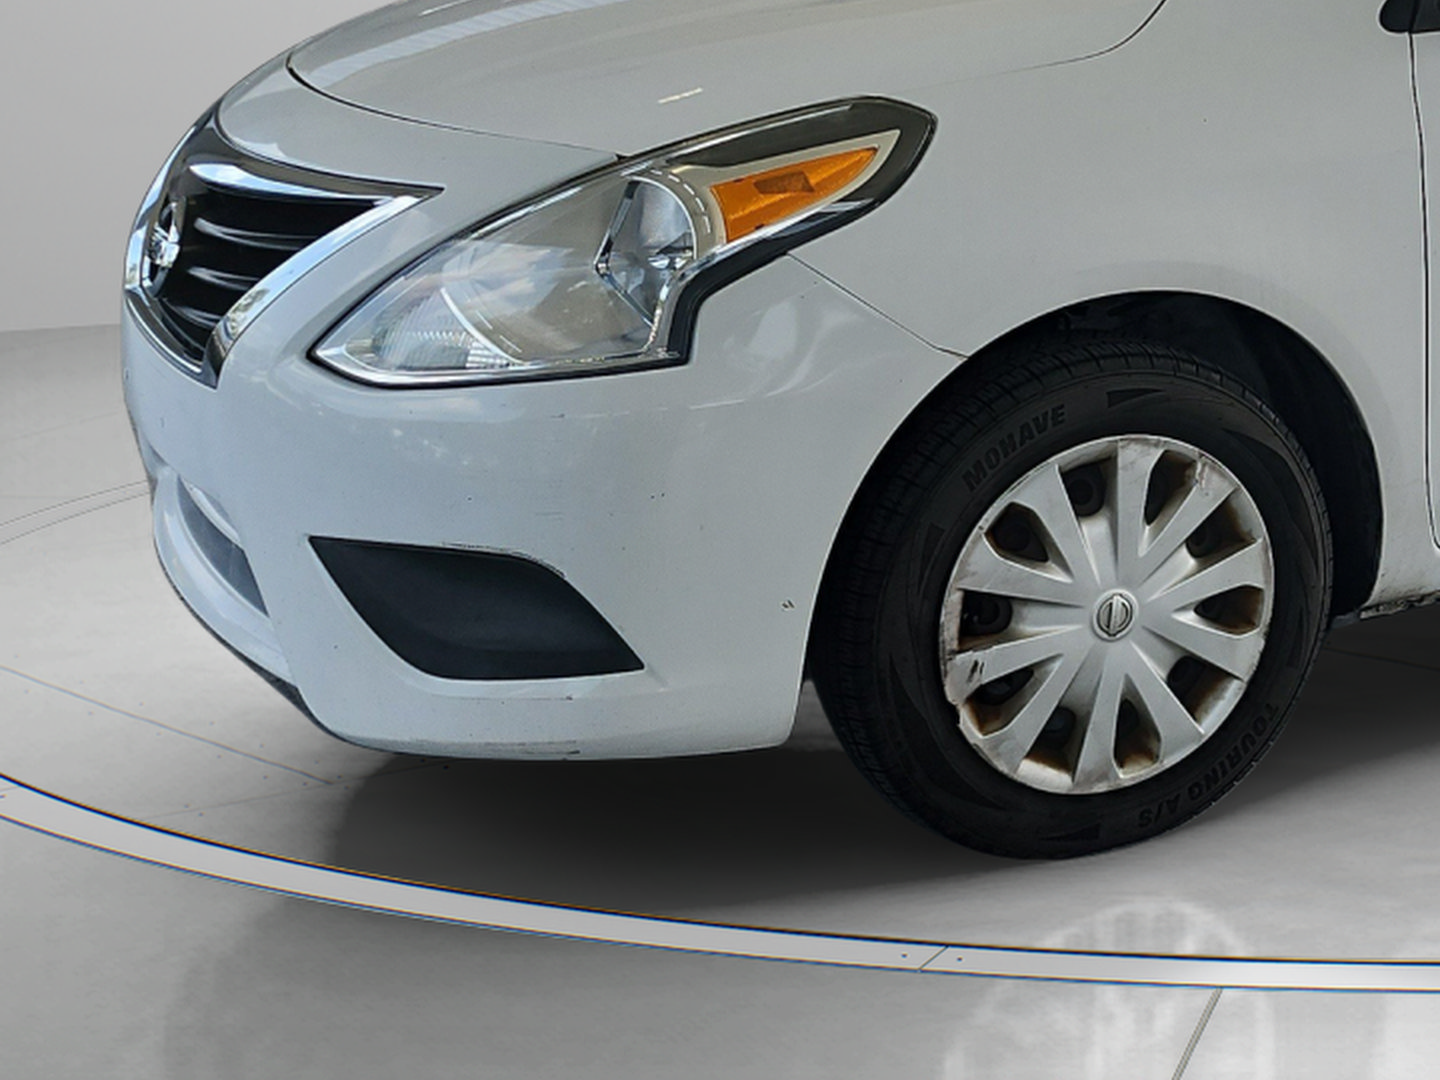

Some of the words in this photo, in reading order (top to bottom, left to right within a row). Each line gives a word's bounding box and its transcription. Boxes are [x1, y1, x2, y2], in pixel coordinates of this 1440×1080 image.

[961, 403, 1065, 491] MOHAVE
[1187, 703, 1279, 801] TOURING
[1138, 793, 1181, 828] A/S
